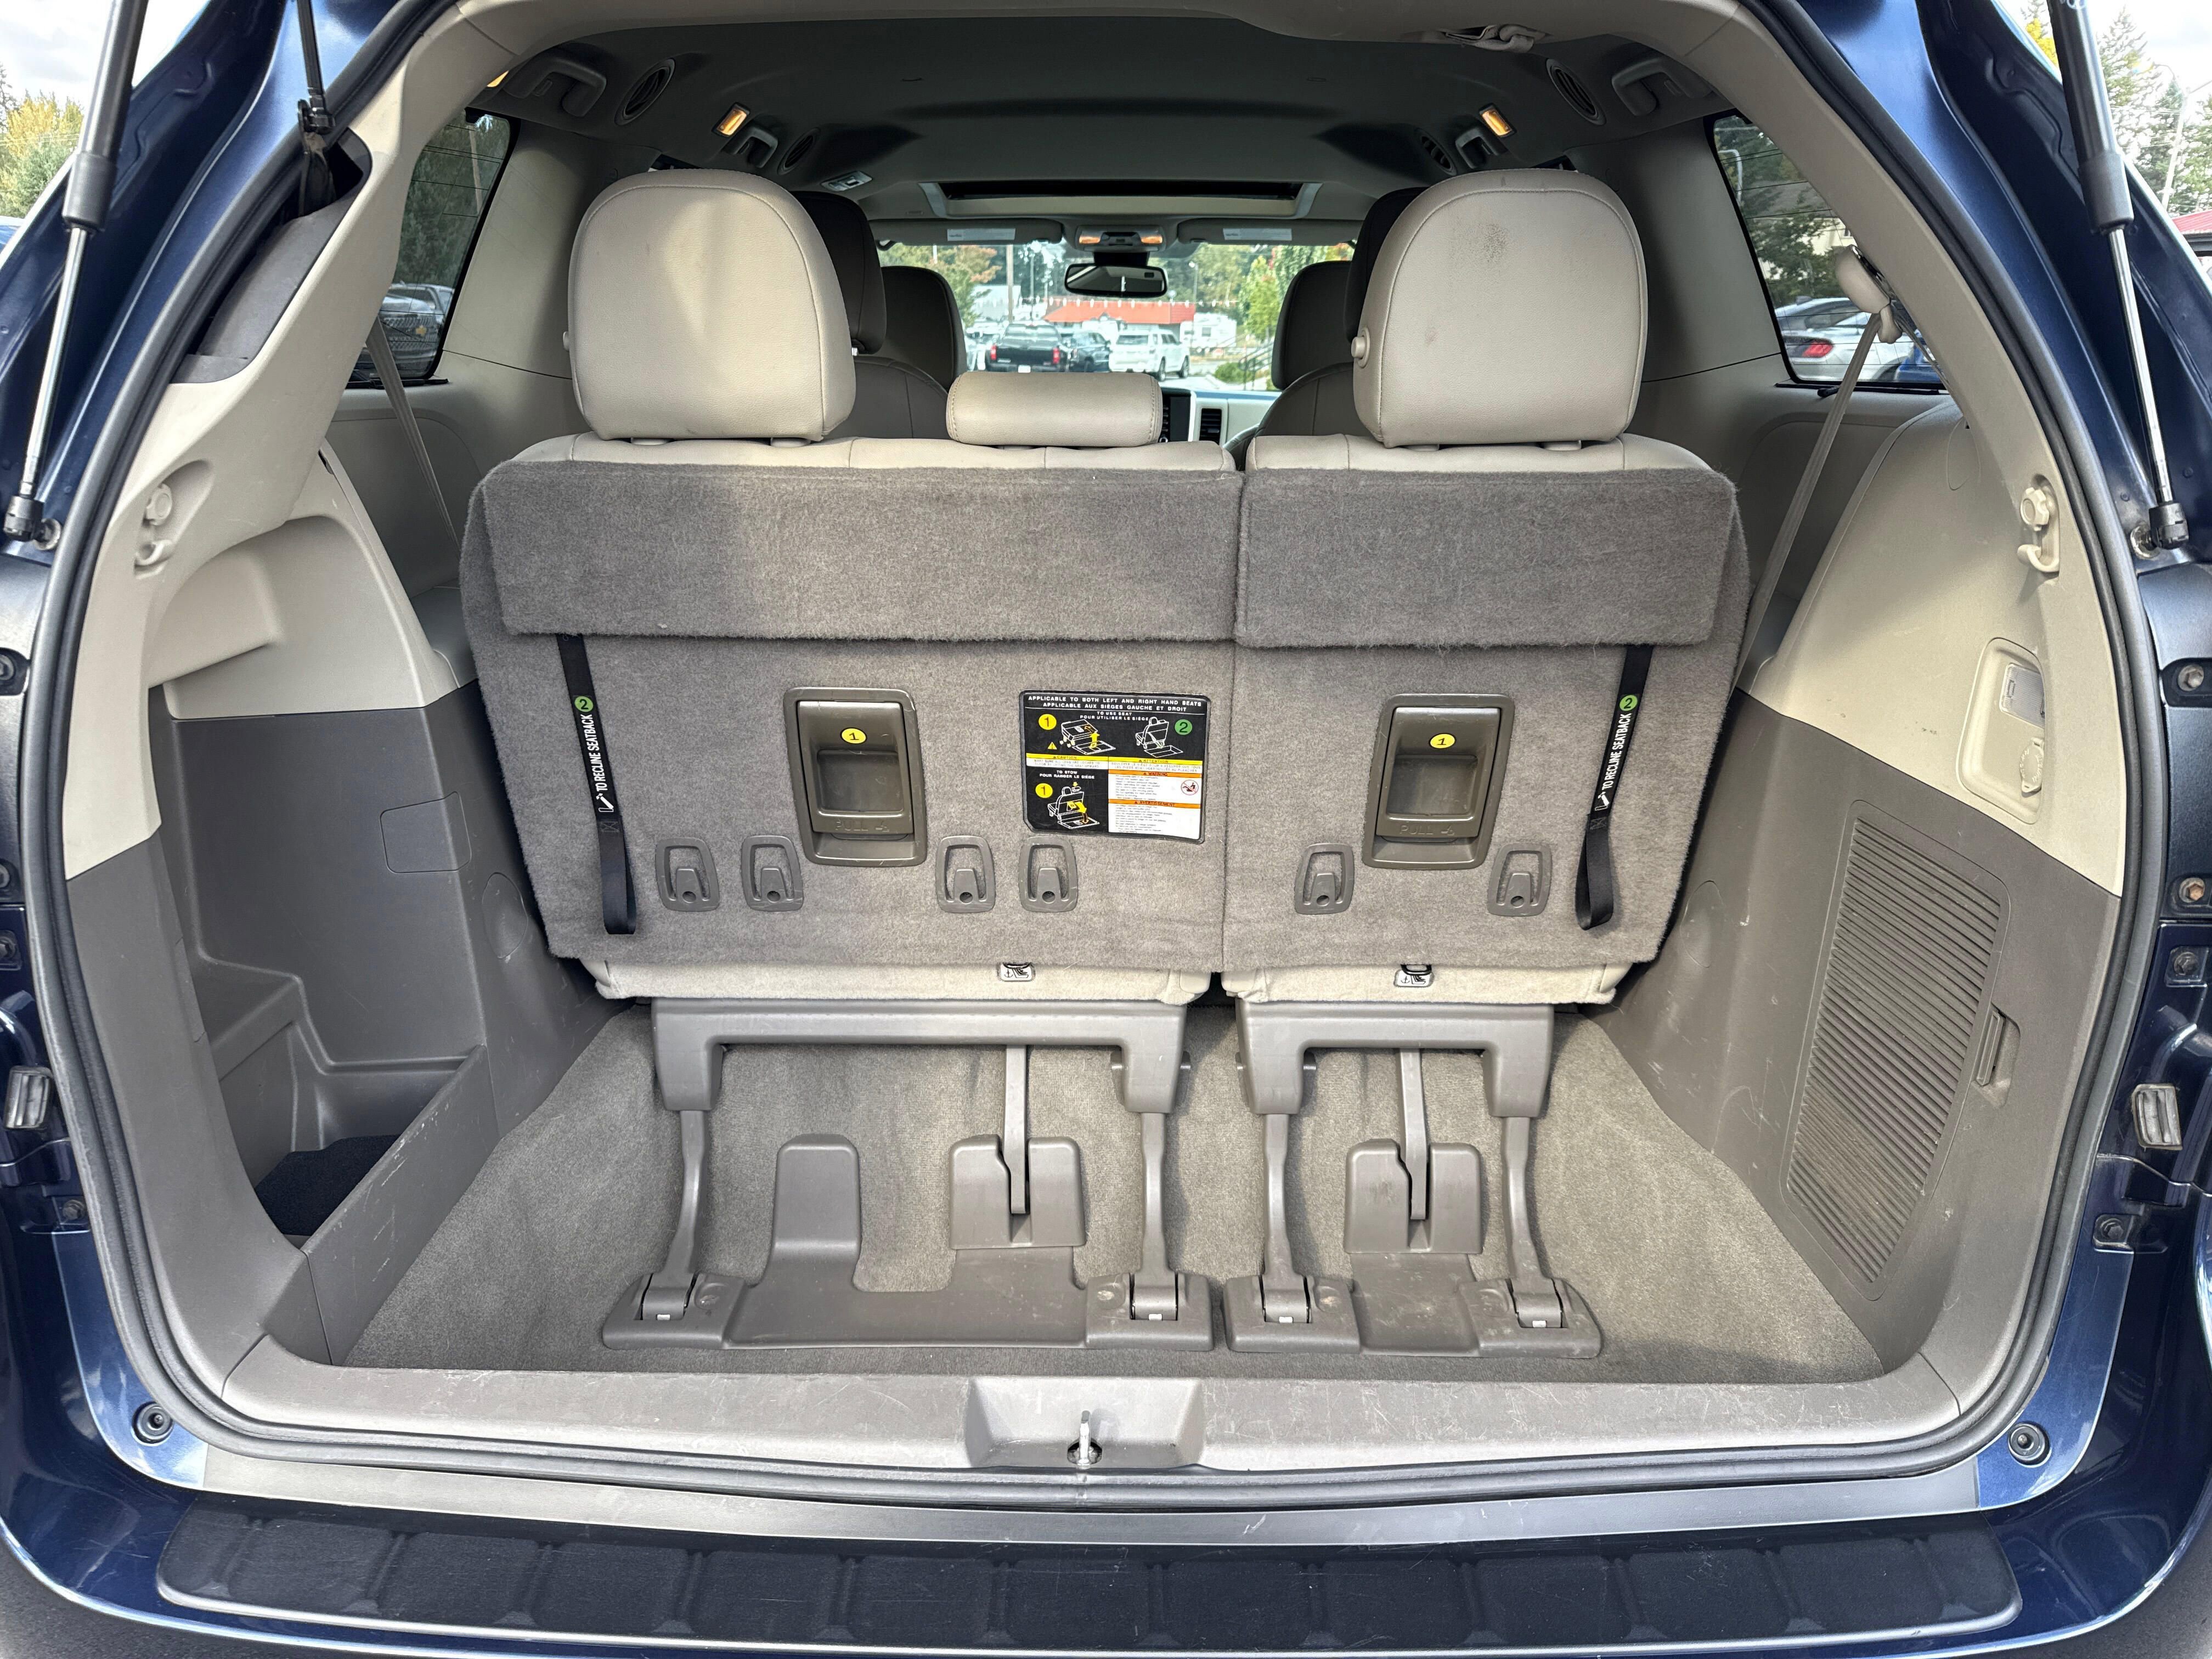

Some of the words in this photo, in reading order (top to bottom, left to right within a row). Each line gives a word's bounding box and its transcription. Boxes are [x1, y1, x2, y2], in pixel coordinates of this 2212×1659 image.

[579, 699, 589, 709] 2
[1623, 697, 1633, 709] 2
[1044, 716, 1049, 727] 1
[580, 714, 600, 751] SEATBACK
[1179, 722, 1188, 733] 2
[1612, 713, 1632, 749] SEATBACK
[589, 752, 606, 781] RECLINE
[1604, 751, 1623, 781] RECLINE
[595, 782, 608, 792] TO
[1040, 786, 1046, 795] 1
[1601, 780, 1613, 791] TO
[835, 820, 868, 831] PULL
[1400, 825, 1434, 834] PULL
